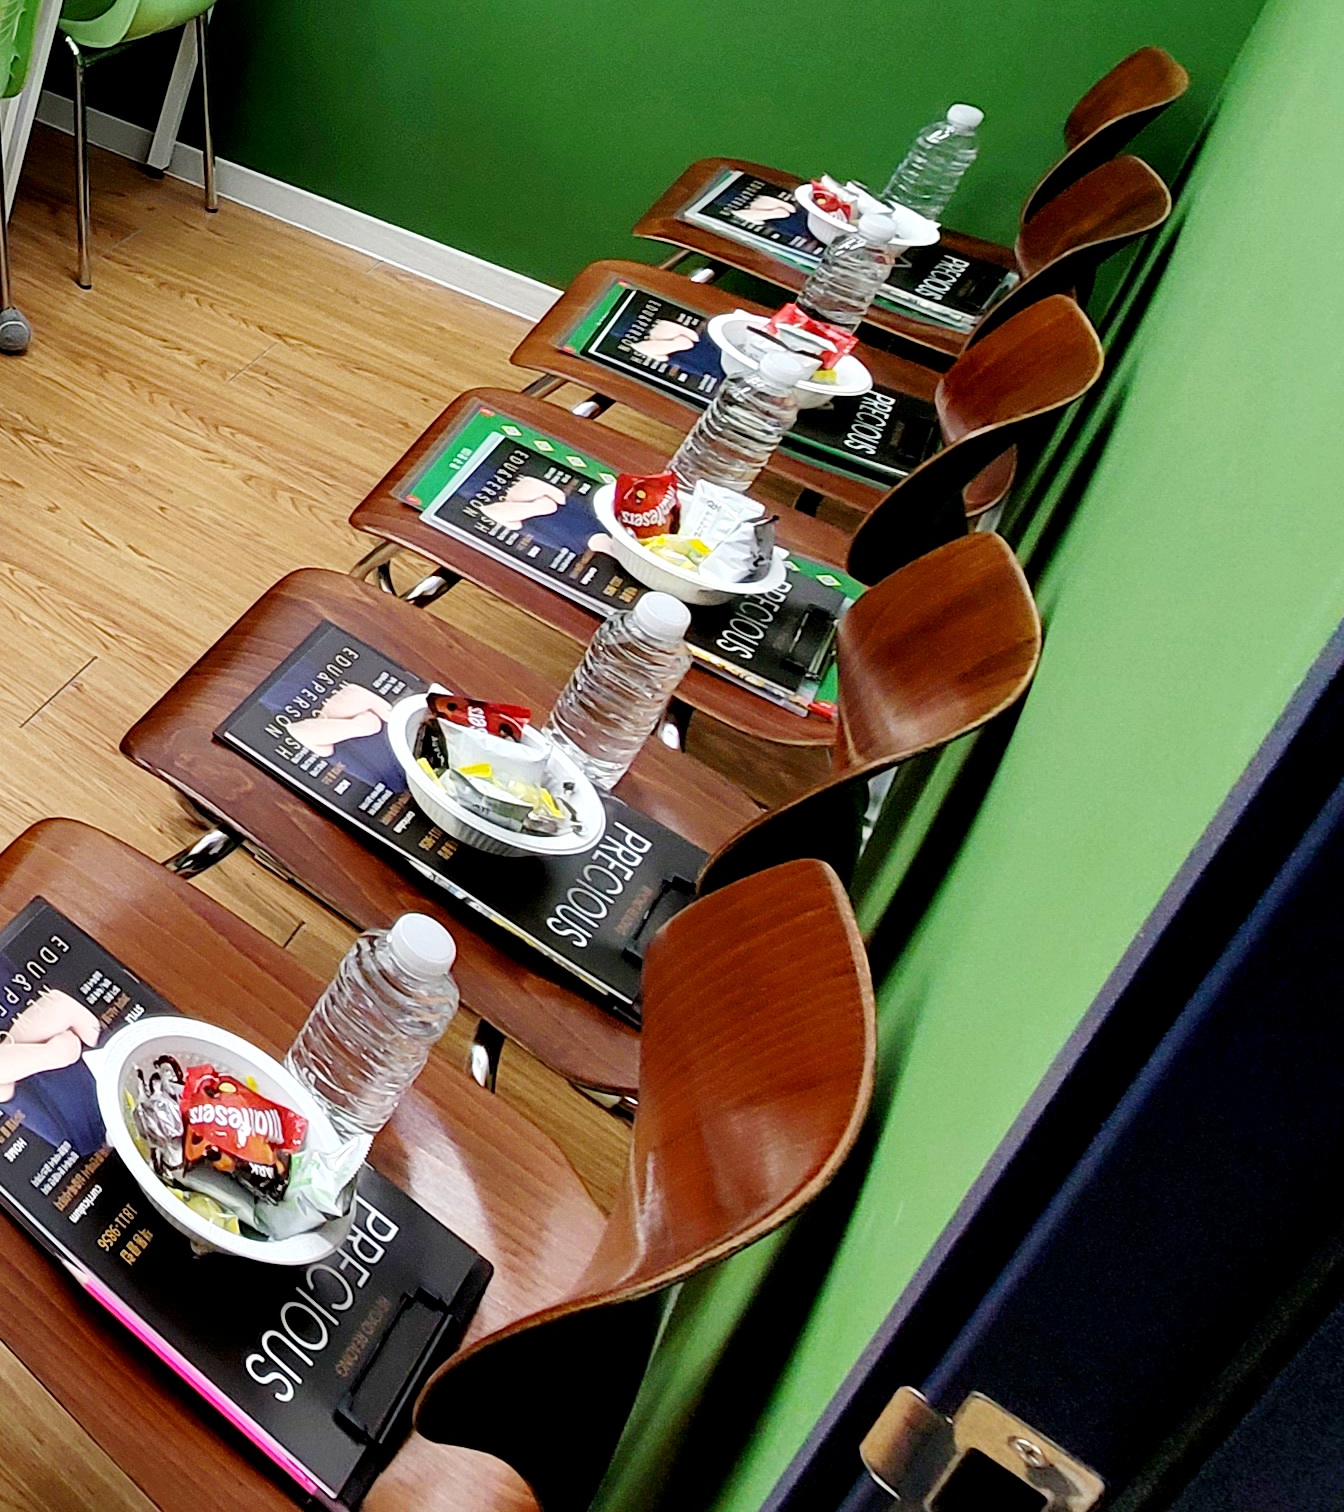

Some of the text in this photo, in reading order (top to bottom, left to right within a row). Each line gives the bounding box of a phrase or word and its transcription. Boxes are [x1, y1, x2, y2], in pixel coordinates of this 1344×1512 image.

[912, 253, 971, 301] PRECIOUS
[840, 388, 900, 456] PRECIOUS
[459, 448, 530, 518] EDU&PERSON
[262, 645, 360, 740] EDU&PERSON
[542, 819, 653, 951] PRECIOUS
[2, 1136, 28, 1163] HOME
[66, 1182, 106, 1226] curriculum
[94, 1201, 140, 1253] 1811-9856
[238, 1194, 400, 1407] PRECIOUS
